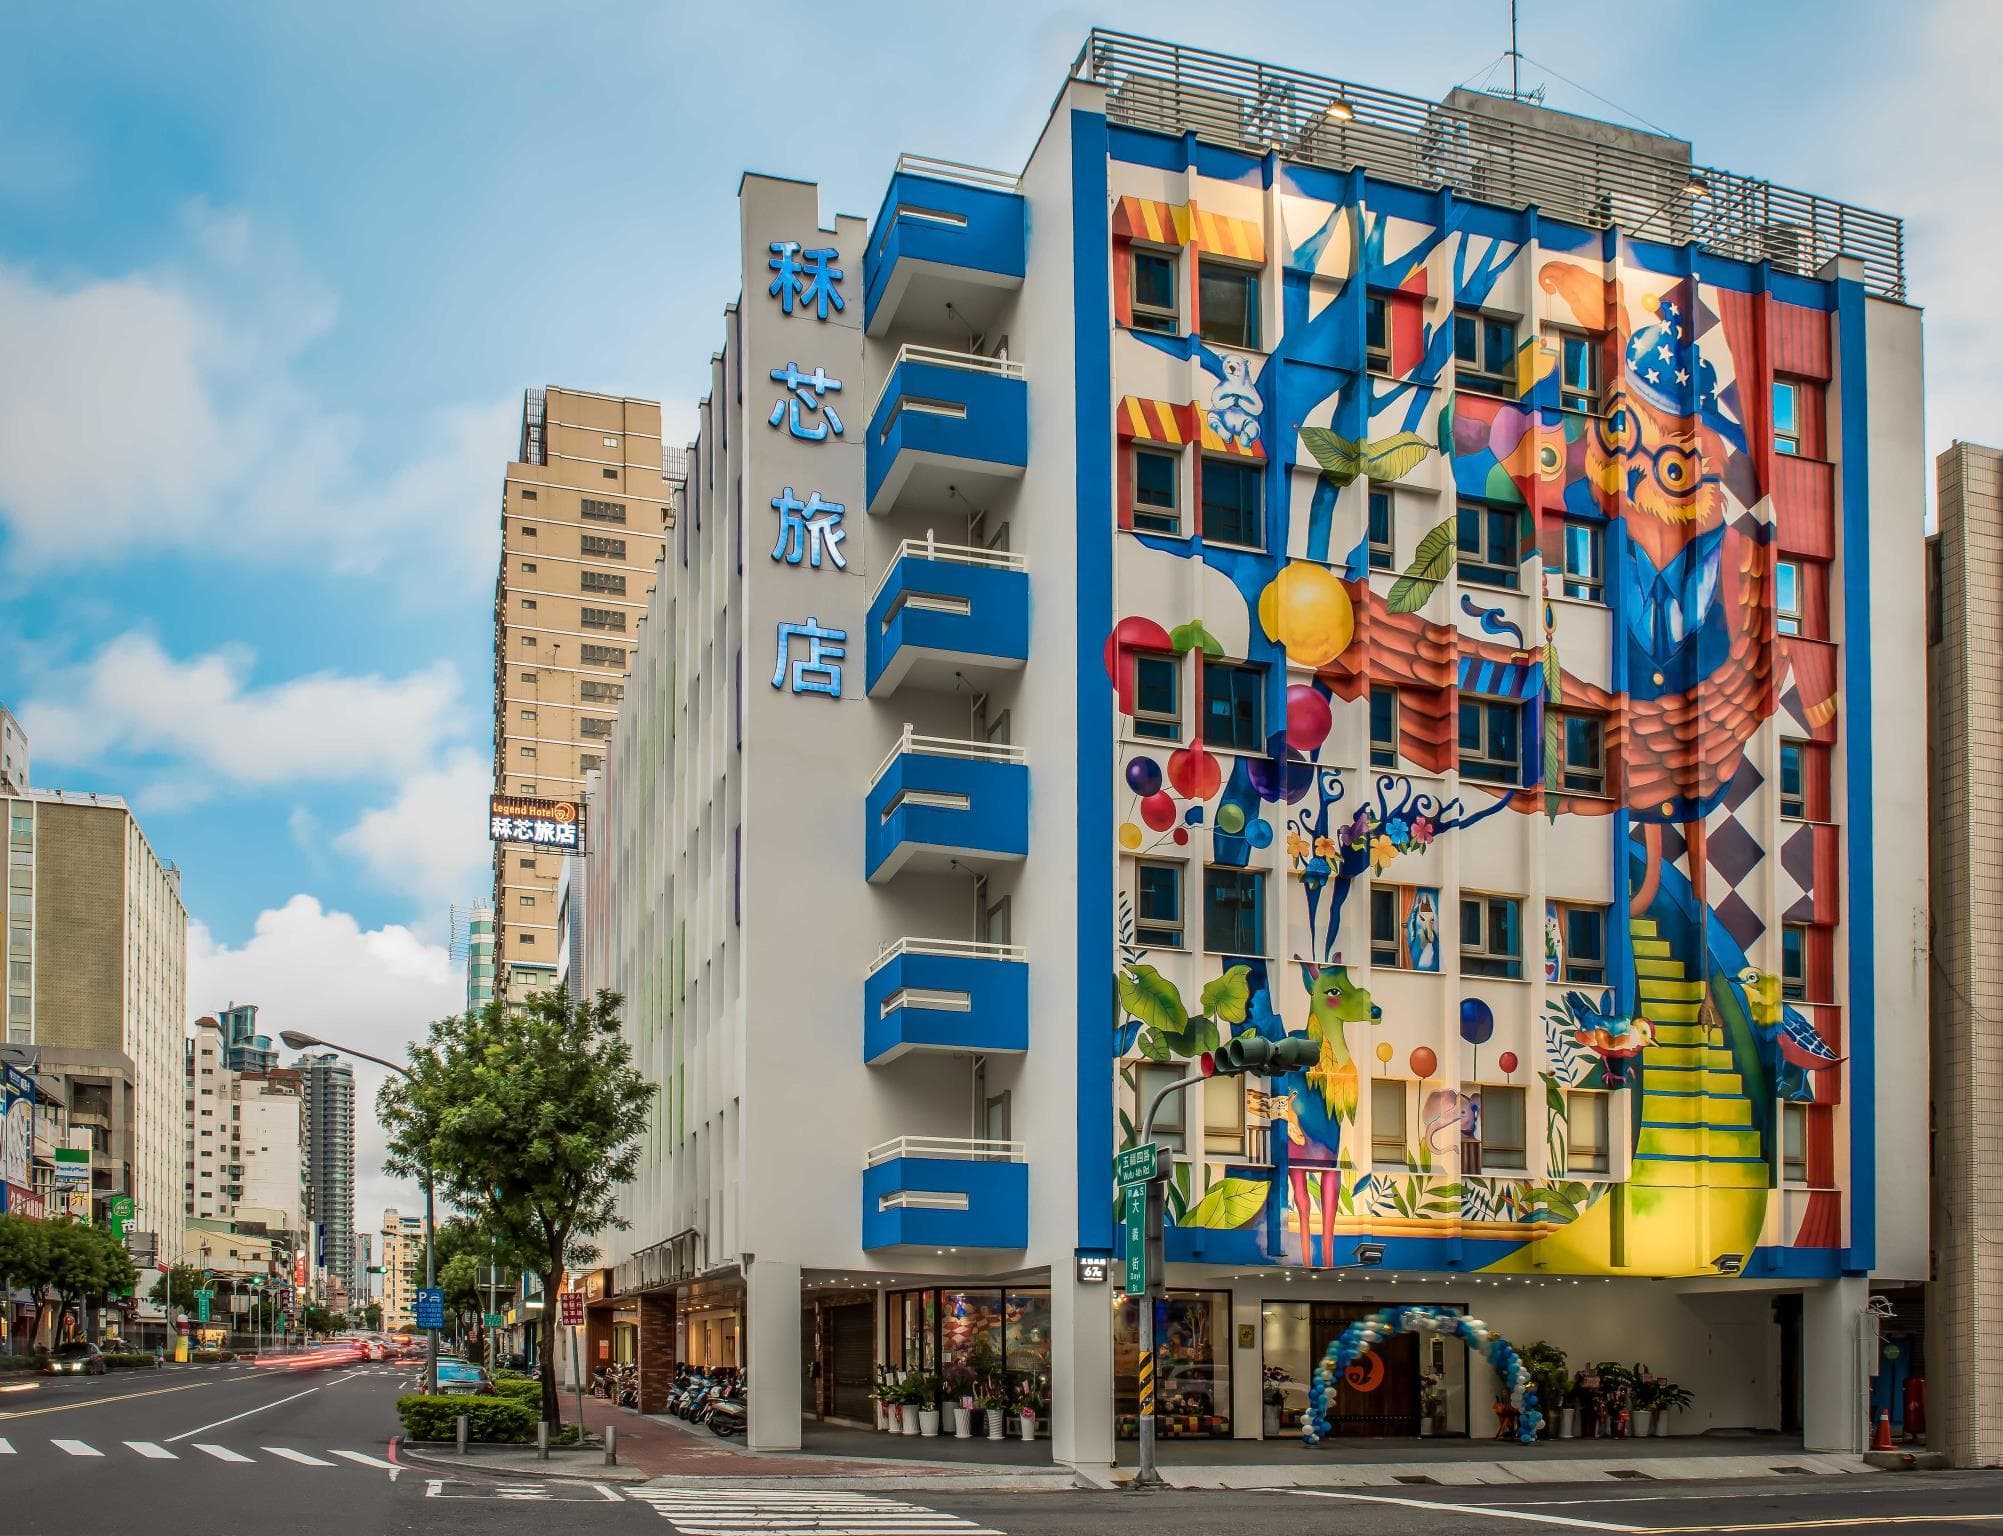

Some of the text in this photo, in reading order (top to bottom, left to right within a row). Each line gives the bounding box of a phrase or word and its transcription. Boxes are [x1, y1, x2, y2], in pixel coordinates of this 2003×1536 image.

[769, 240, 846, 698] 秝芯旅店
[493, 802, 554, 818] Legend Hotel
[1122, 1149, 1150, 1168] 五福四路
[56, 1165, 88, 1173] FamilyMart
